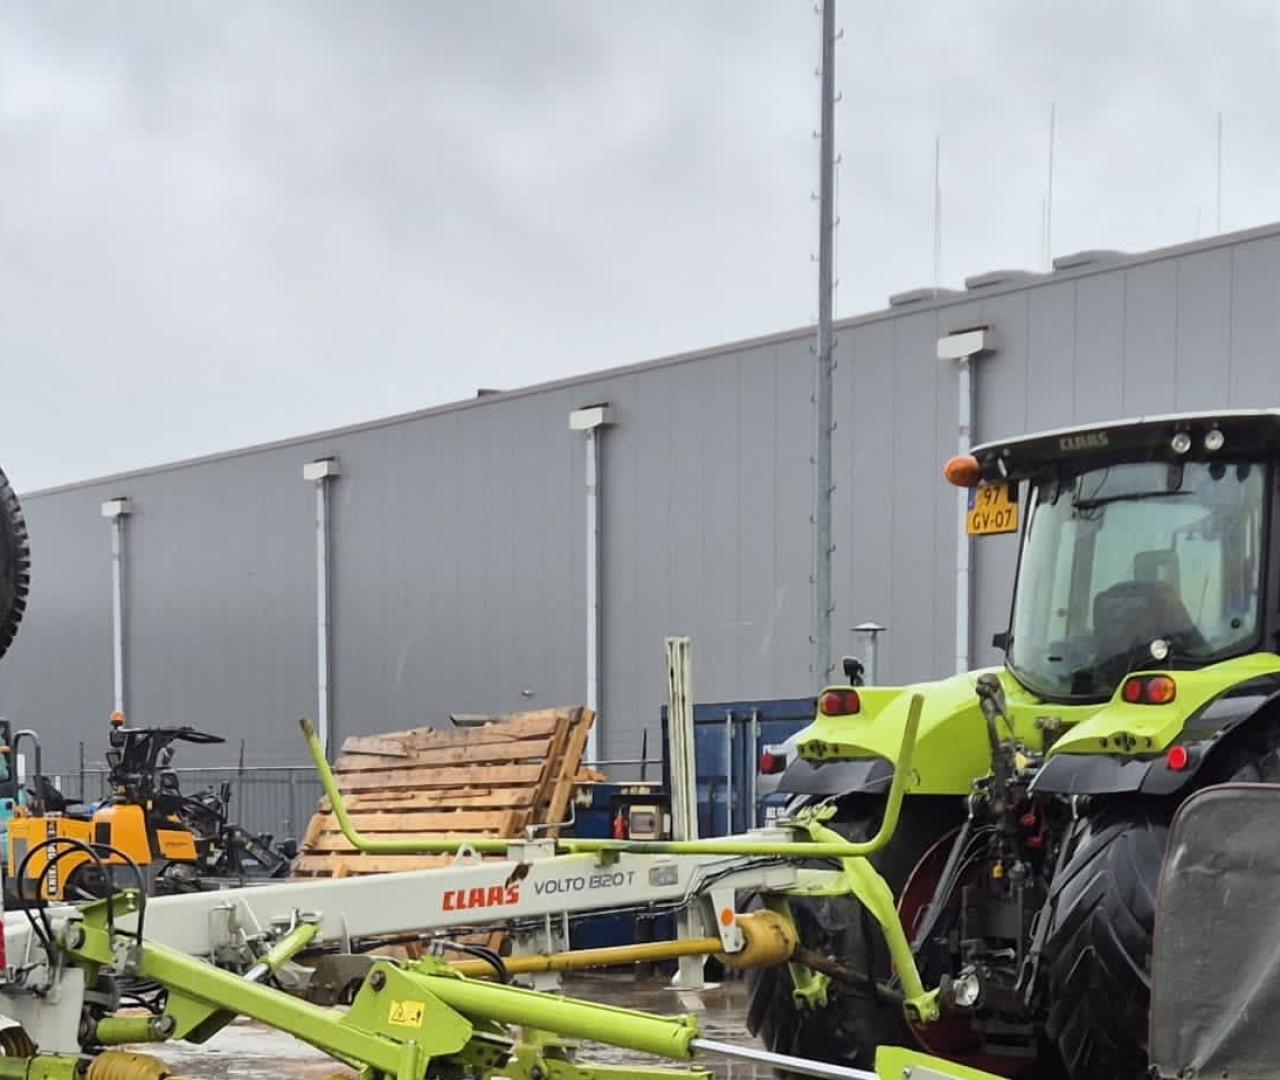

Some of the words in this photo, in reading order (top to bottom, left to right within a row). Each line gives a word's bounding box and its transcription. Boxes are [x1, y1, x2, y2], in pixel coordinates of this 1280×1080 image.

[1059, 432, 1109, 451] CLAAS
[984, 486, 1000, 506] 97
[973, 510, 1012, 530] GV-07
[442, 884, 520, 912] CLAAS
[534, 877, 585, 895] VOLTO
